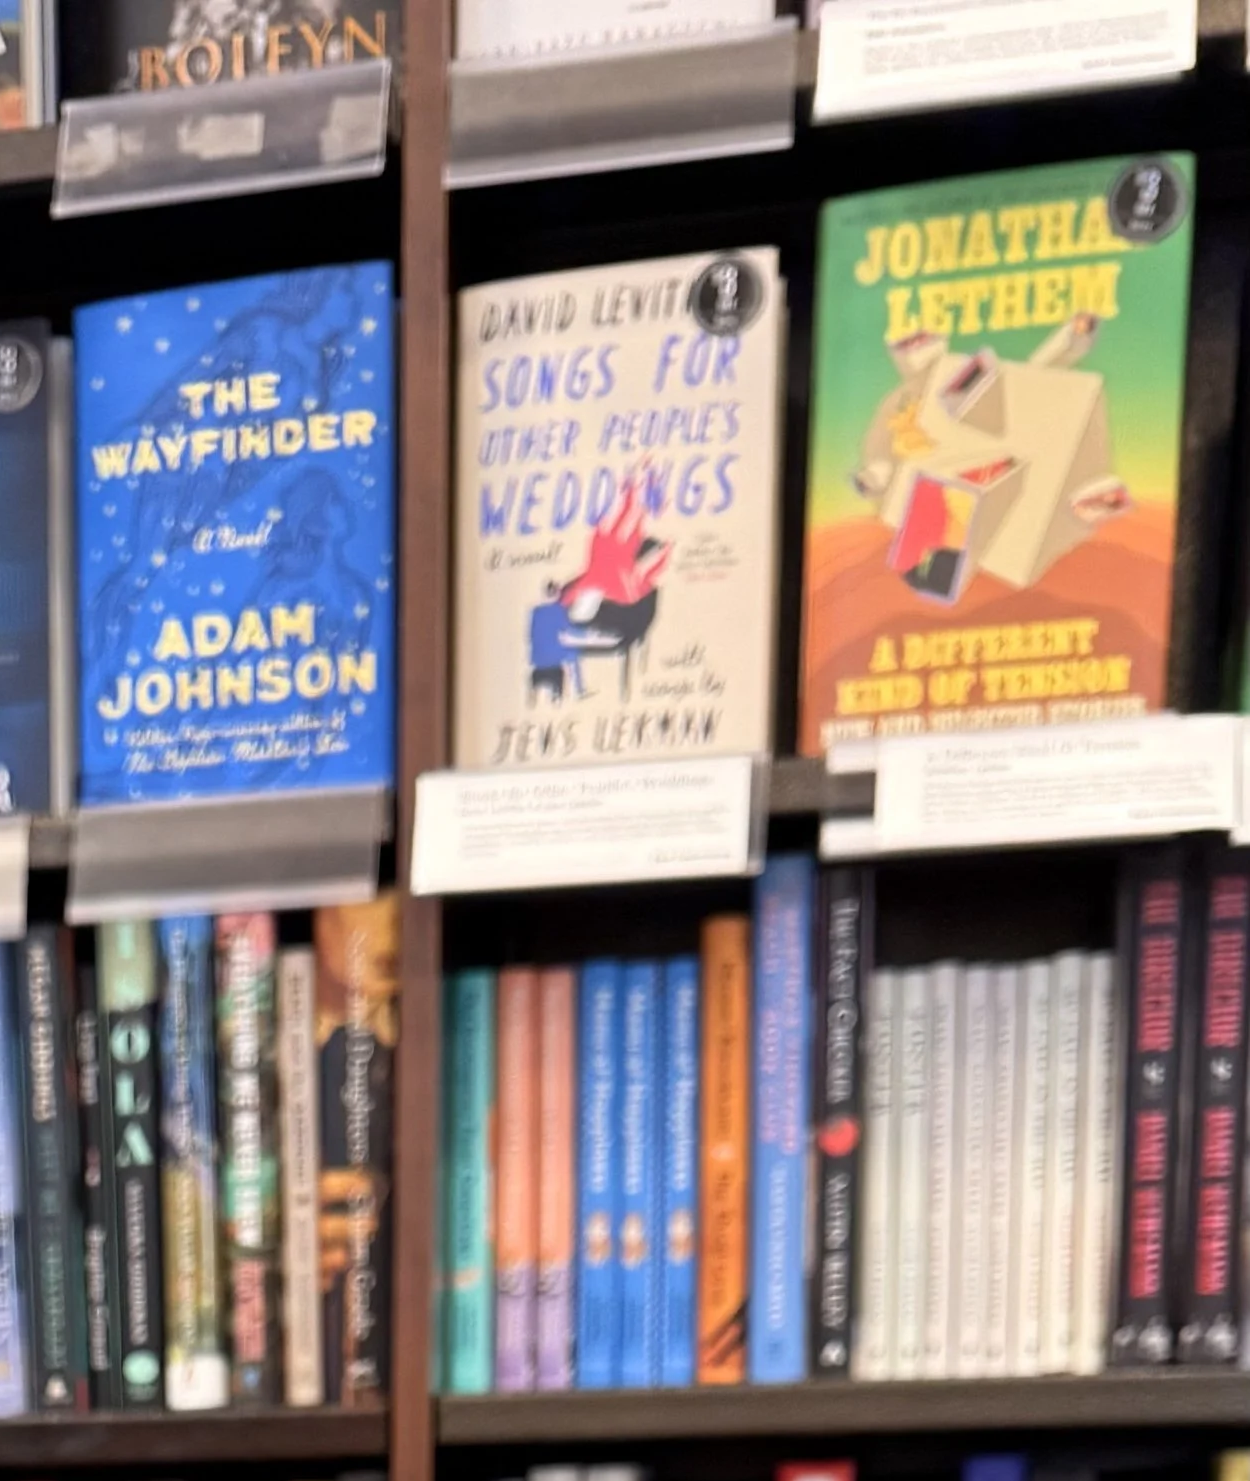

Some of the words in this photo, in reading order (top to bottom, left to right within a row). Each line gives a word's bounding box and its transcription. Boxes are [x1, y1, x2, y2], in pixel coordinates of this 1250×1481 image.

[479, 291, 575, 342] DAVID
[886, 263, 1121, 340] LETHEM
[179, 372, 282, 420] THE
[479, 343, 619, 414] SONGS
[652, 332, 743, 394] FOR
[92, 410, 377, 481] WAYFINDER
[478, 418, 581, 468] OTHER
[597, 400, 742, 453] PEOPLE'S
[478, 454, 742, 539] WEDDINGS
[154, 602, 316, 663] ADAM
[869, 635, 899, 673] A
[901, 617, 1100, 671] DIFFERENT
[98, 651, 377, 721] JOHNSON
[836, 673, 924, 715] KIND
[927, 667, 977, 708] OF
[980, 655, 1132, 701] TENSION
[490, 713, 579, 767] JENS
[592, 707, 723, 755] LEKMAN
[1140, 934, 1177, 1053] DIRECTOR
[1202, 930, 1247, 1047] DIRECTOR
[824, 1004, 857, 1104] CHECKER
[341, 1032, 374, 1166] Daughters
[1135, 1111, 1167, 1181] DANIEL
[1203, 1107, 1236, 1178] DANIEL
